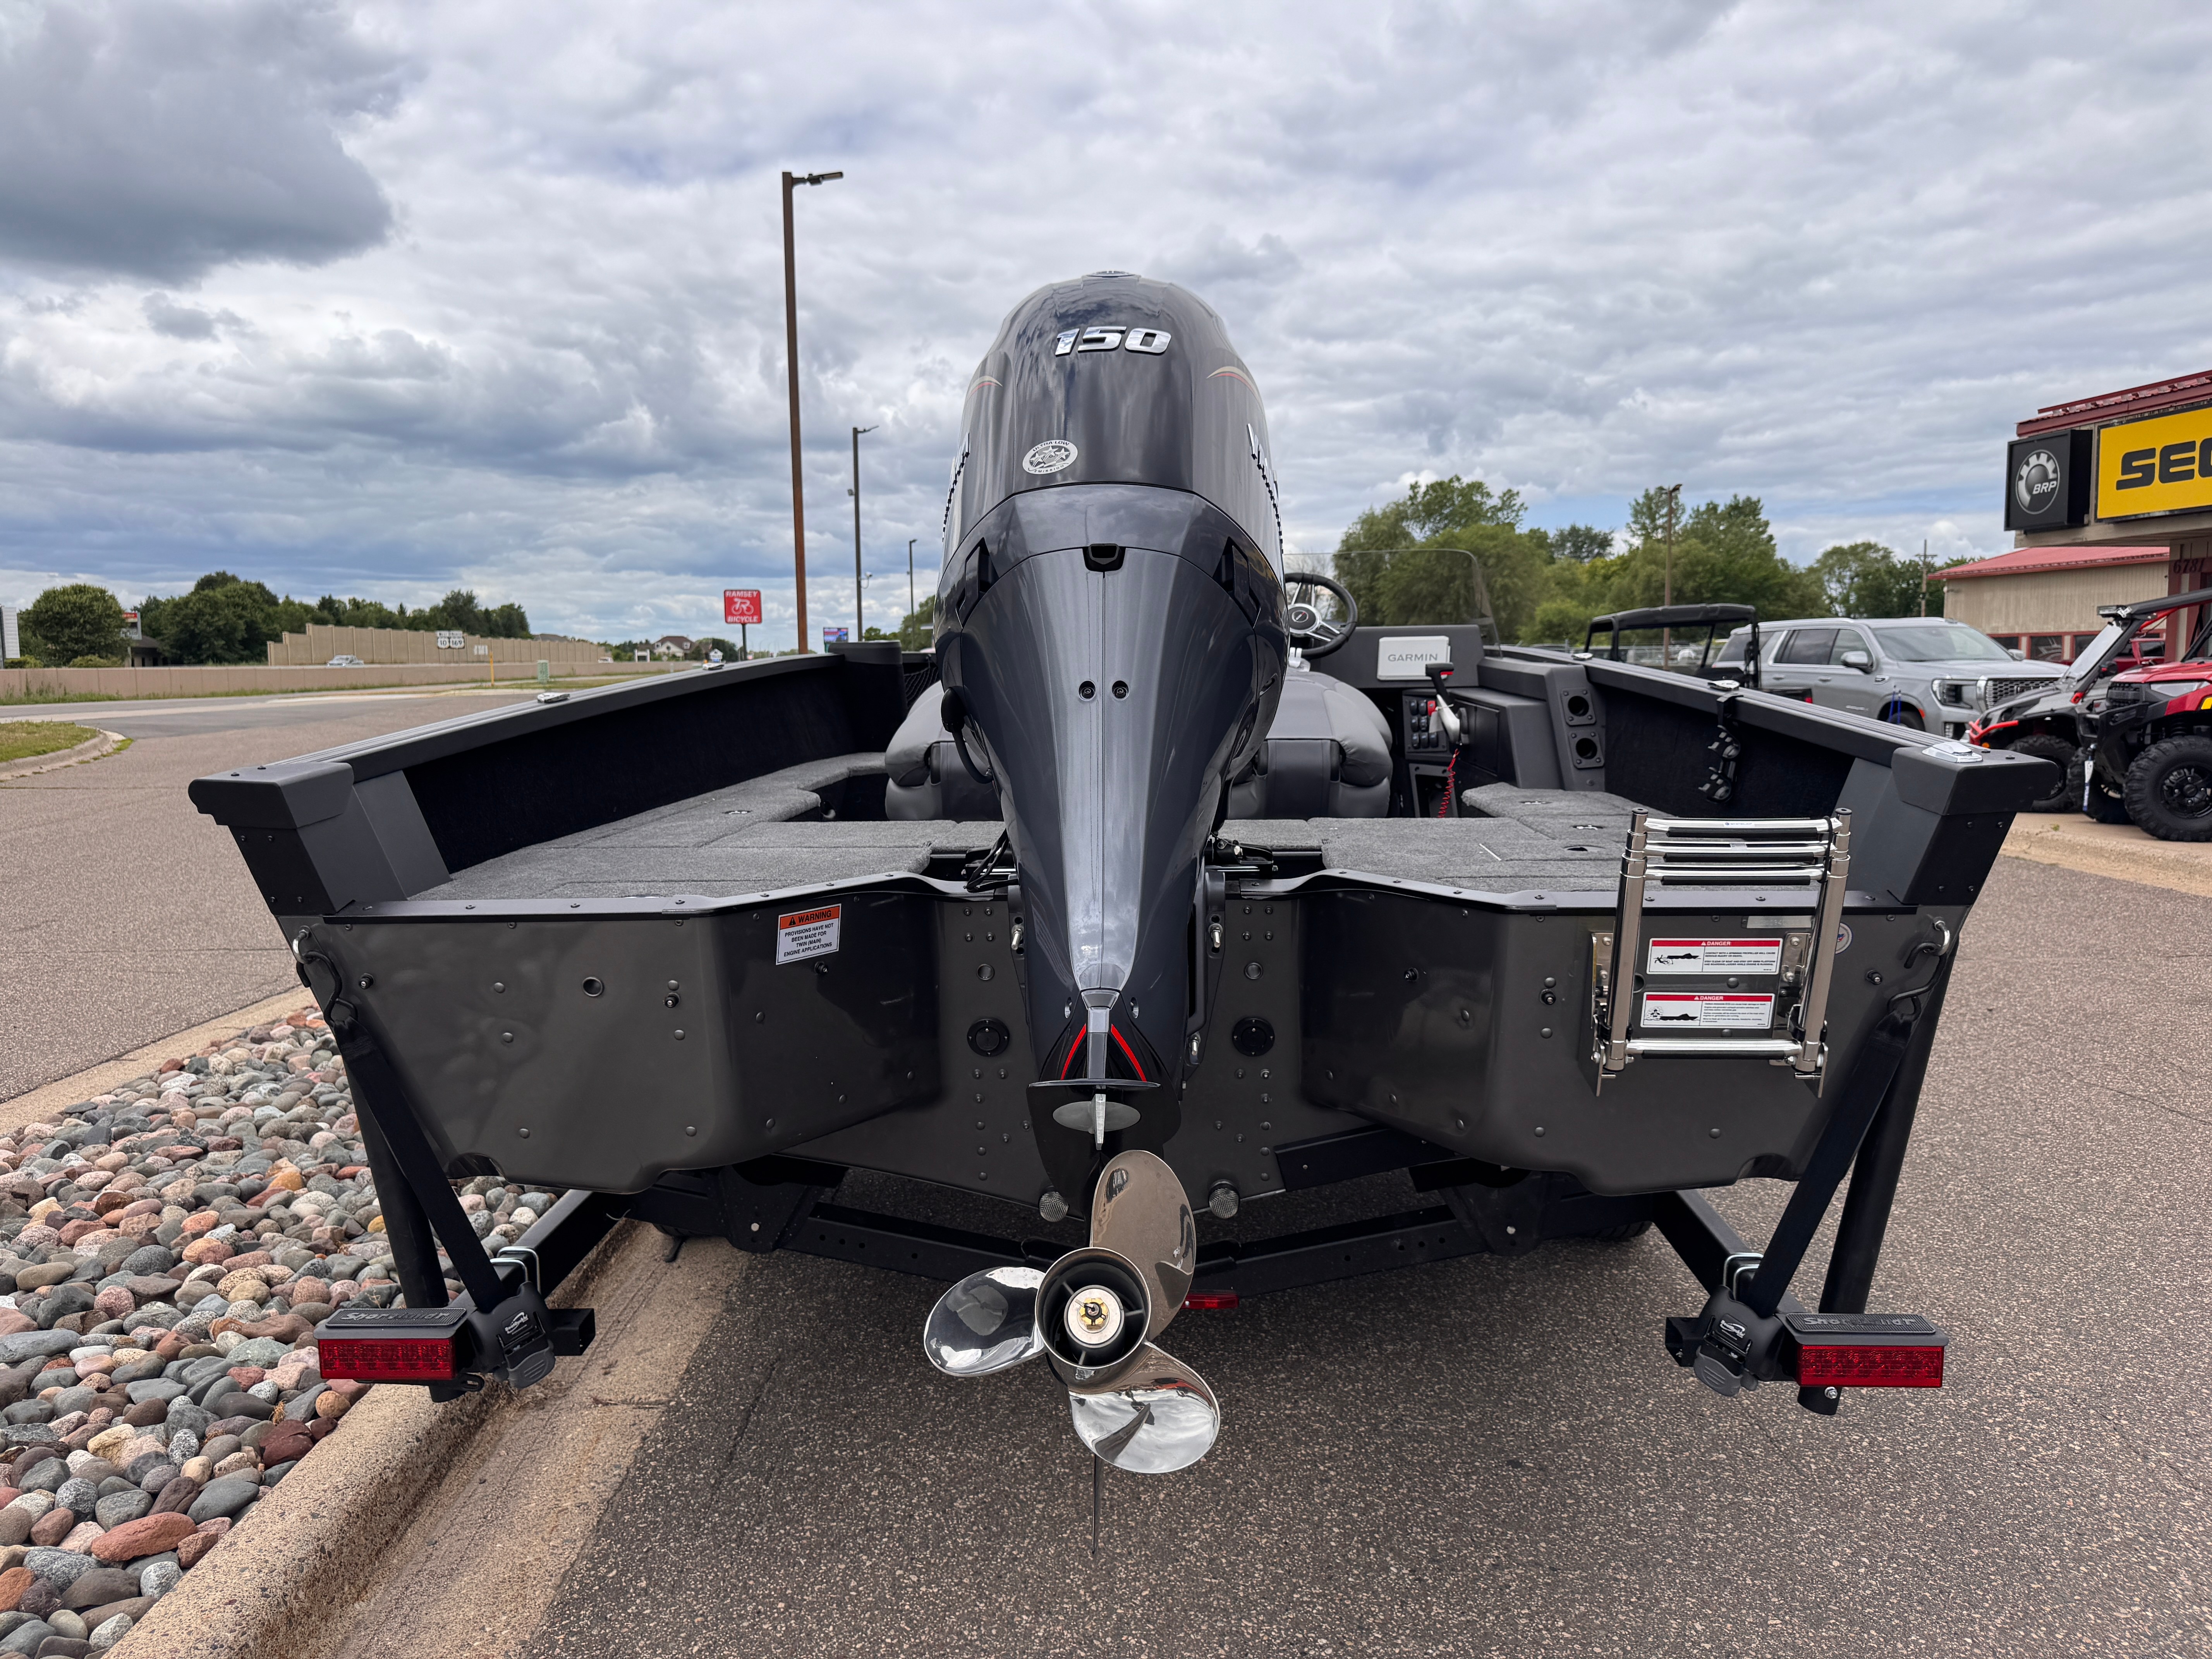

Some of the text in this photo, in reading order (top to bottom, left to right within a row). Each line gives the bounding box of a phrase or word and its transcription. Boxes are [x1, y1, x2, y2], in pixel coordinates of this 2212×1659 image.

[1055, 326, 1171, 357] 150
[2032, 481, 2057, 495] BRP
[2174, 558, 2206, 574] 6781
[1388, 653, 1437, 662] GARMIN
[798, 910, 831, 923] WARNING
[785, 928, 811, 937] PROVISIONS
[801, 942, 832, 953] APPLICATIONS
